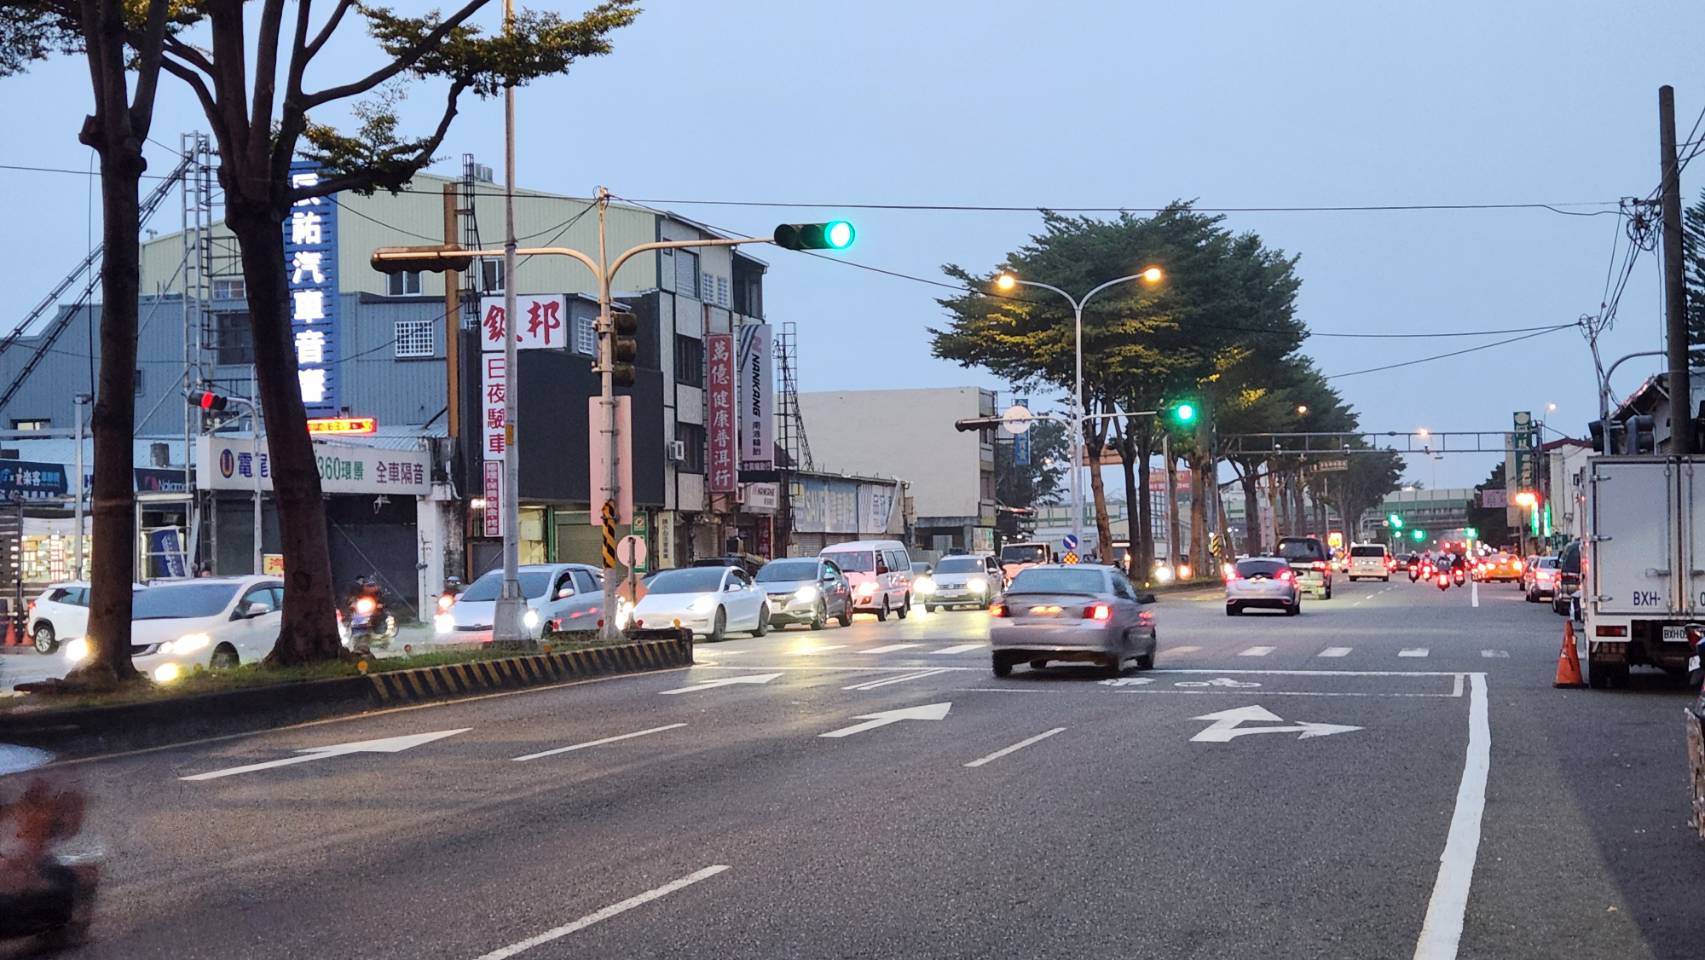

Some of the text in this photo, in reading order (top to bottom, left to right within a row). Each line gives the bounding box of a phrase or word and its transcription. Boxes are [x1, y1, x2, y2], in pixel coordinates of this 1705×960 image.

[751, 353, 761, 418] NANKANG
[376, 460, 424, 485] 全車隔音
